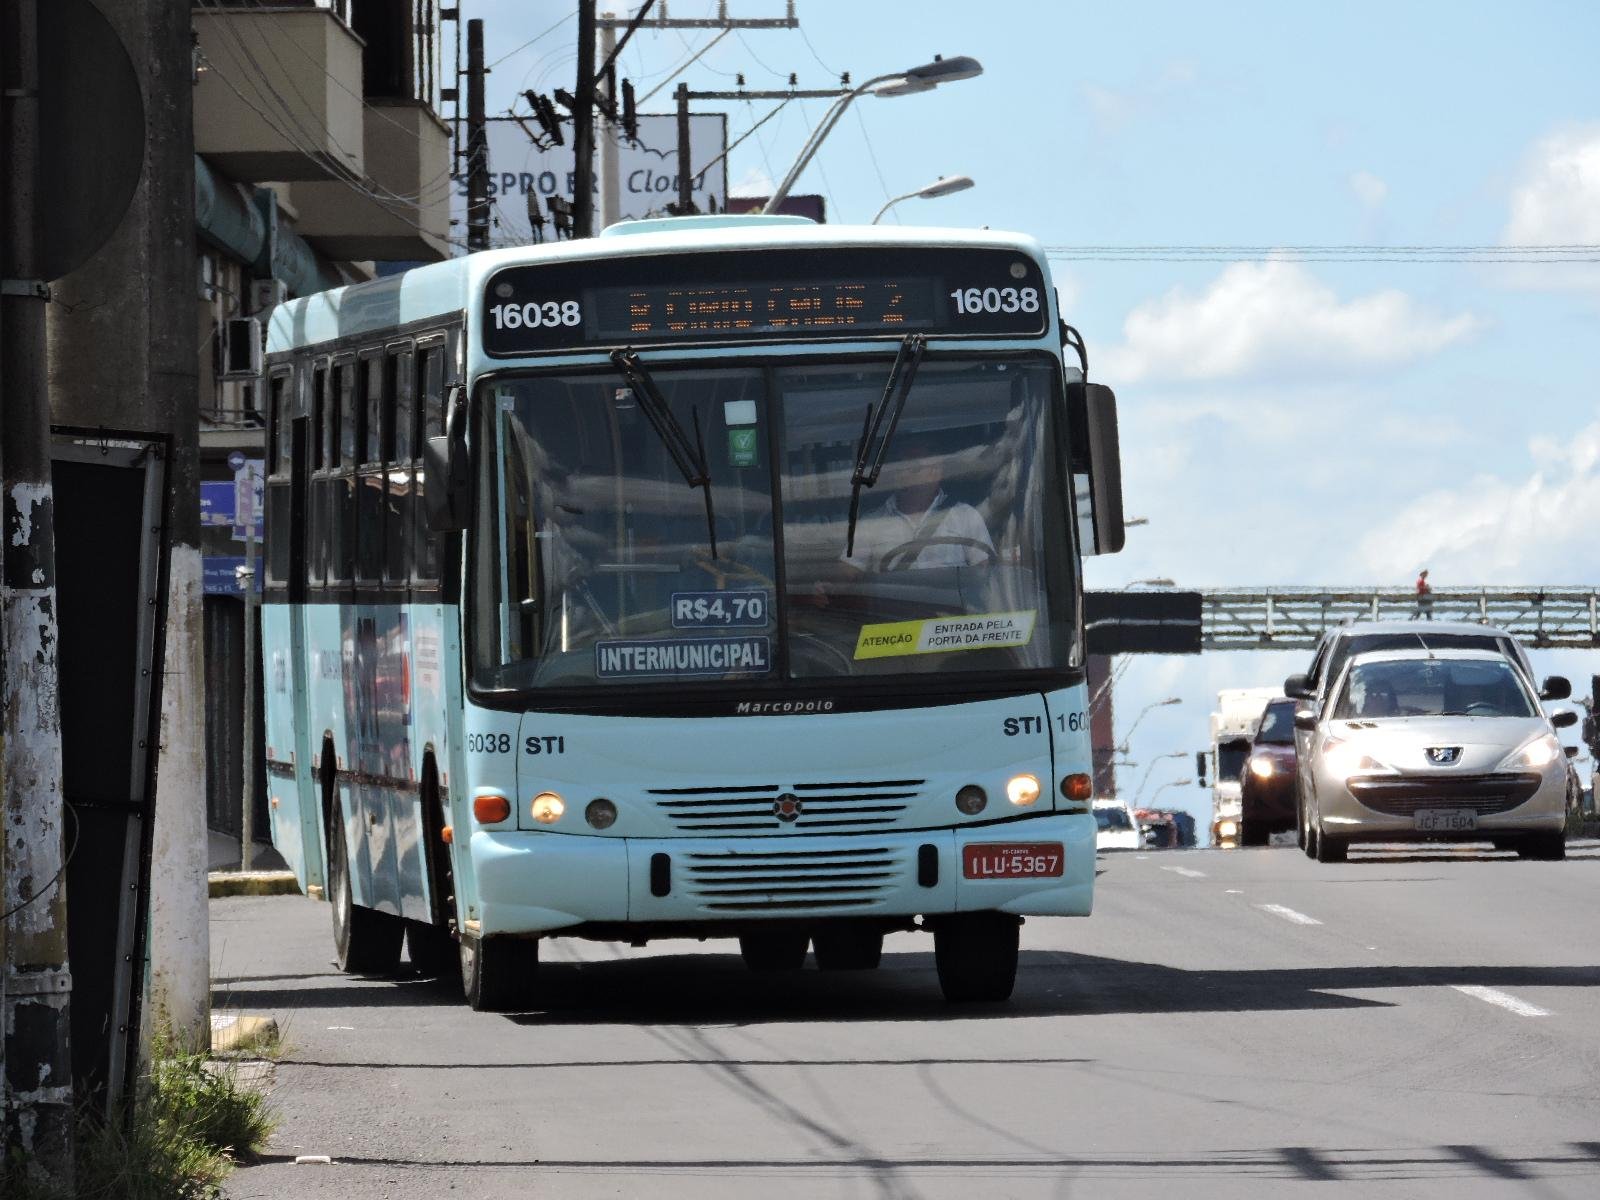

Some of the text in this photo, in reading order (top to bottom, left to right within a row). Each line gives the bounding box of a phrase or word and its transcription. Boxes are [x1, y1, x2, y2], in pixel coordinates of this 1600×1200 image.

[456, 171, 557, 196] SSPRO
[950, 287, 1040, 314] 16038
[489, 300, 581, 330] 16038
[676, 598, 763, 624] R$4,70
[935, 620, 1014, 634] ENTRADA PELA
[862, 633, 913, 647] ATENÇÃO
[928, 630, 1023, 647] PORTA DA FRENTE
[600, 642, 765, 672] INTERMUNICIPAL
[737, 700, 833, 713] Marcopolo
[1003, 716, 1042, 737] STI
[525, 735, 565, 755] STI
